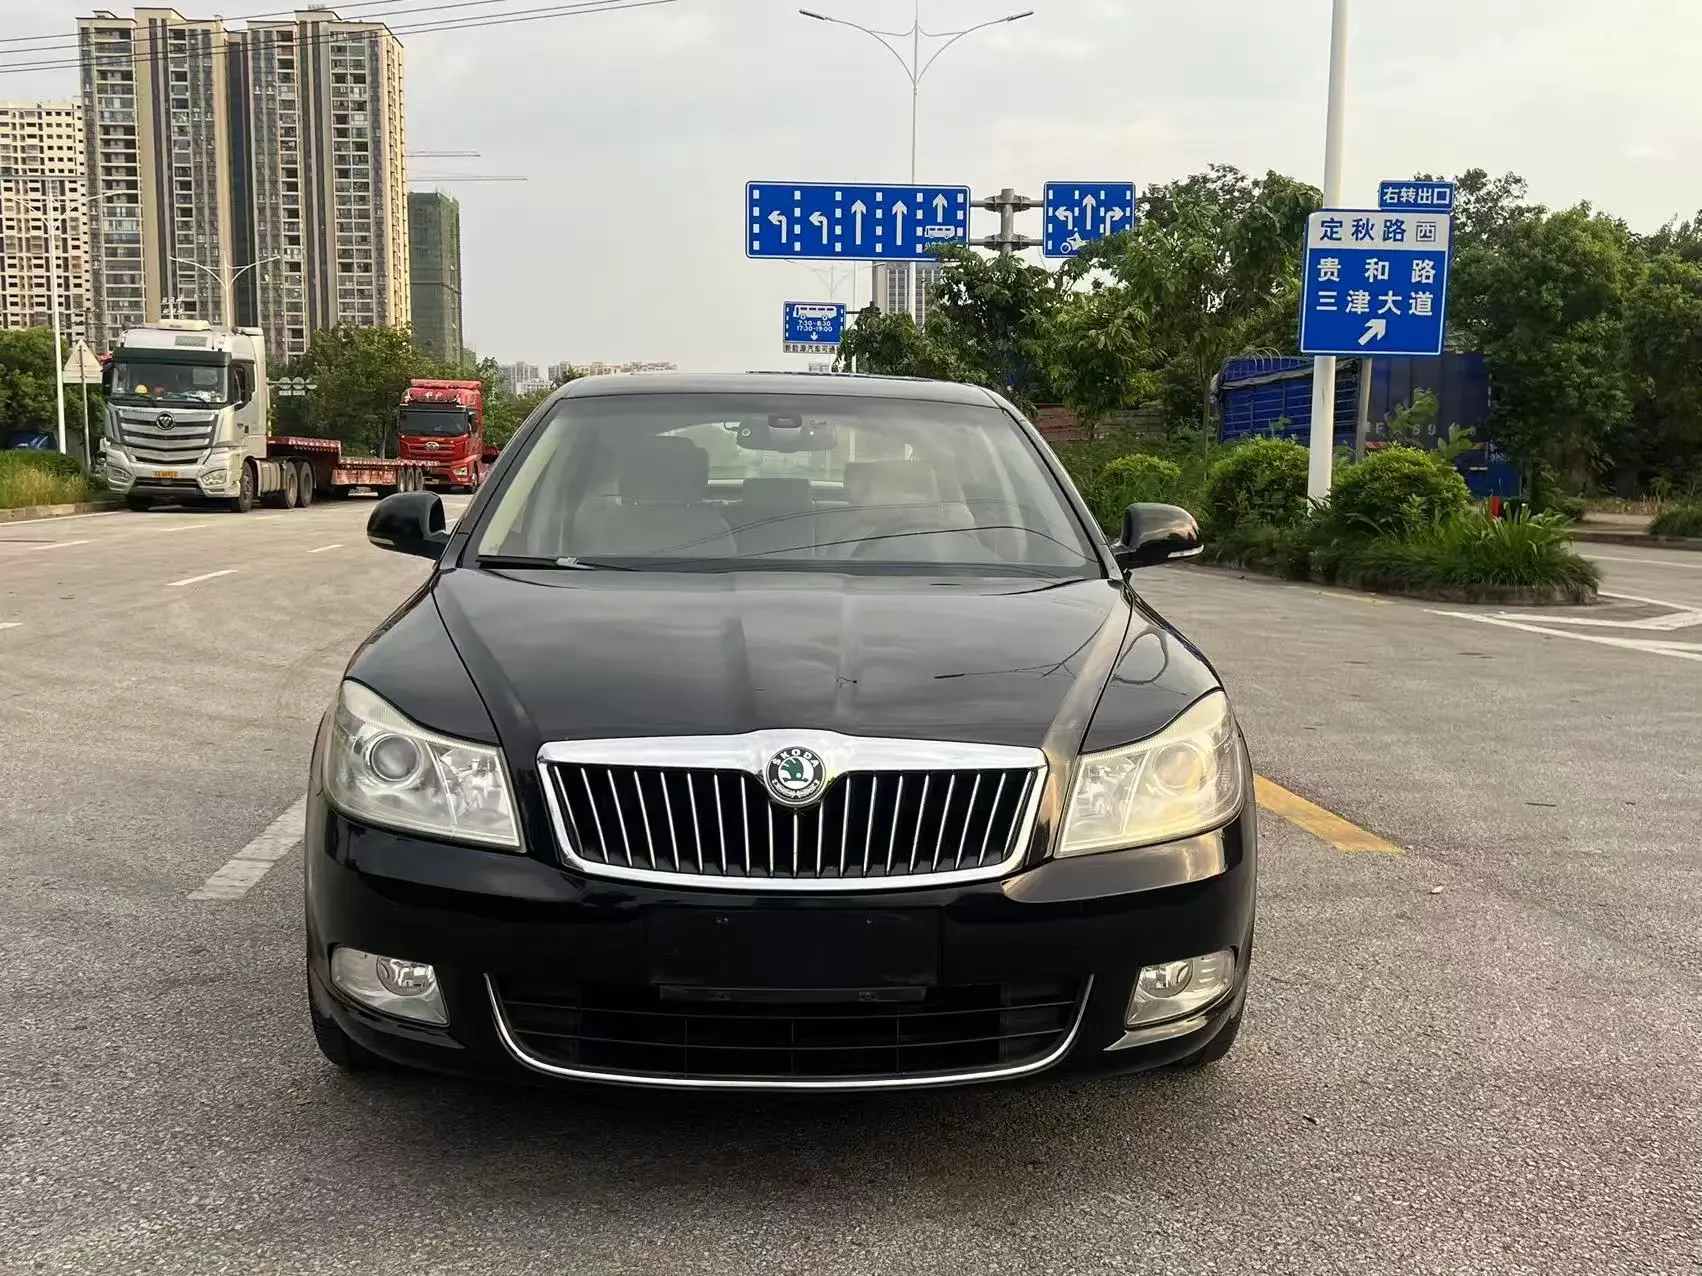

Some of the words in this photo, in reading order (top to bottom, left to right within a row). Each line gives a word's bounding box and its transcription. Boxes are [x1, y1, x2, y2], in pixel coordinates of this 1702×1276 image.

[1383, 187, 1450, 204] 右转出口
[1317, 257, 1436, 284] 贵和路
[1316, 289, 1434, 316] 三津大道
